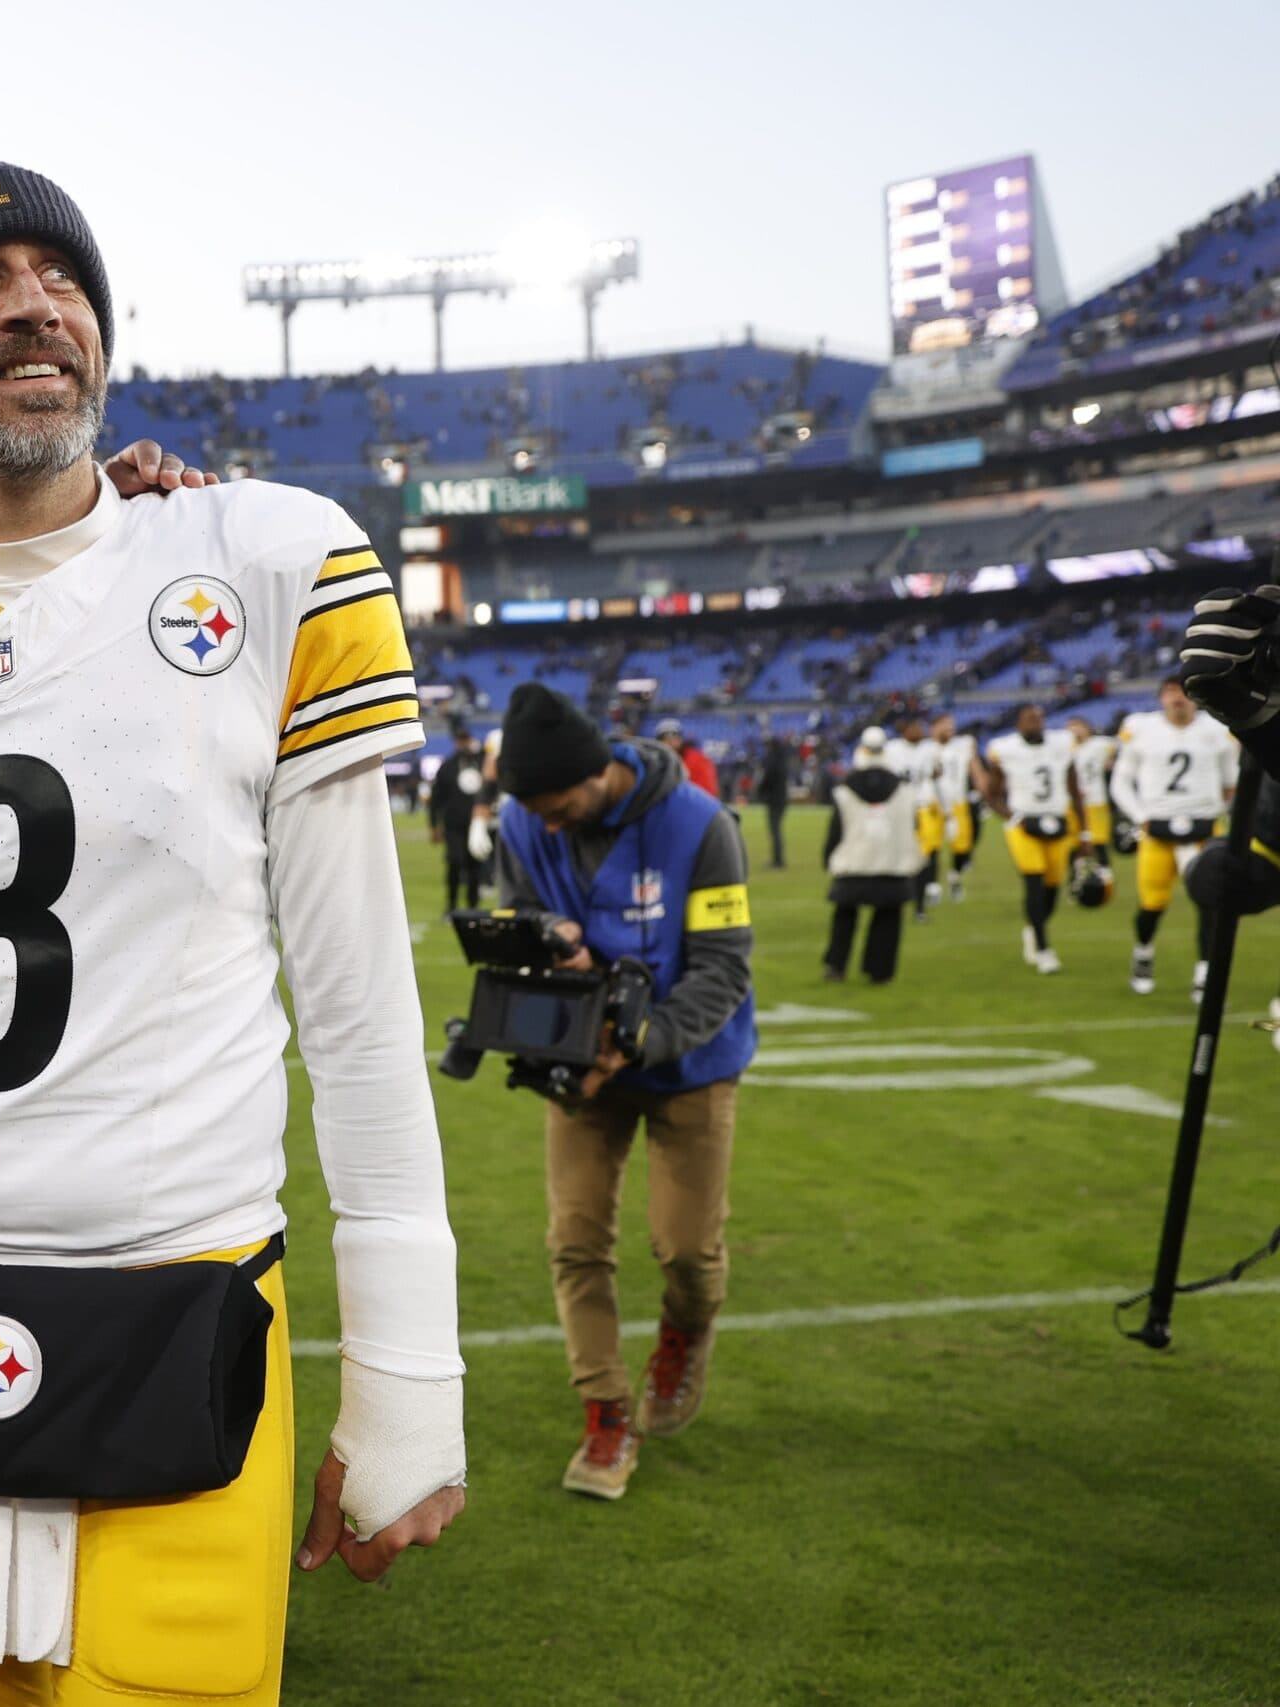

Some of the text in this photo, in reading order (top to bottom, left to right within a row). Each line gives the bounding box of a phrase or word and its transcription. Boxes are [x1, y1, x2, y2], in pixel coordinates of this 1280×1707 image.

[495, 477, 571, 513] Bank
[160, 616, 199, 629] Steelers
[1032, 765, 1053, 800] 3
[1167, 750, 1192, 793] 2
